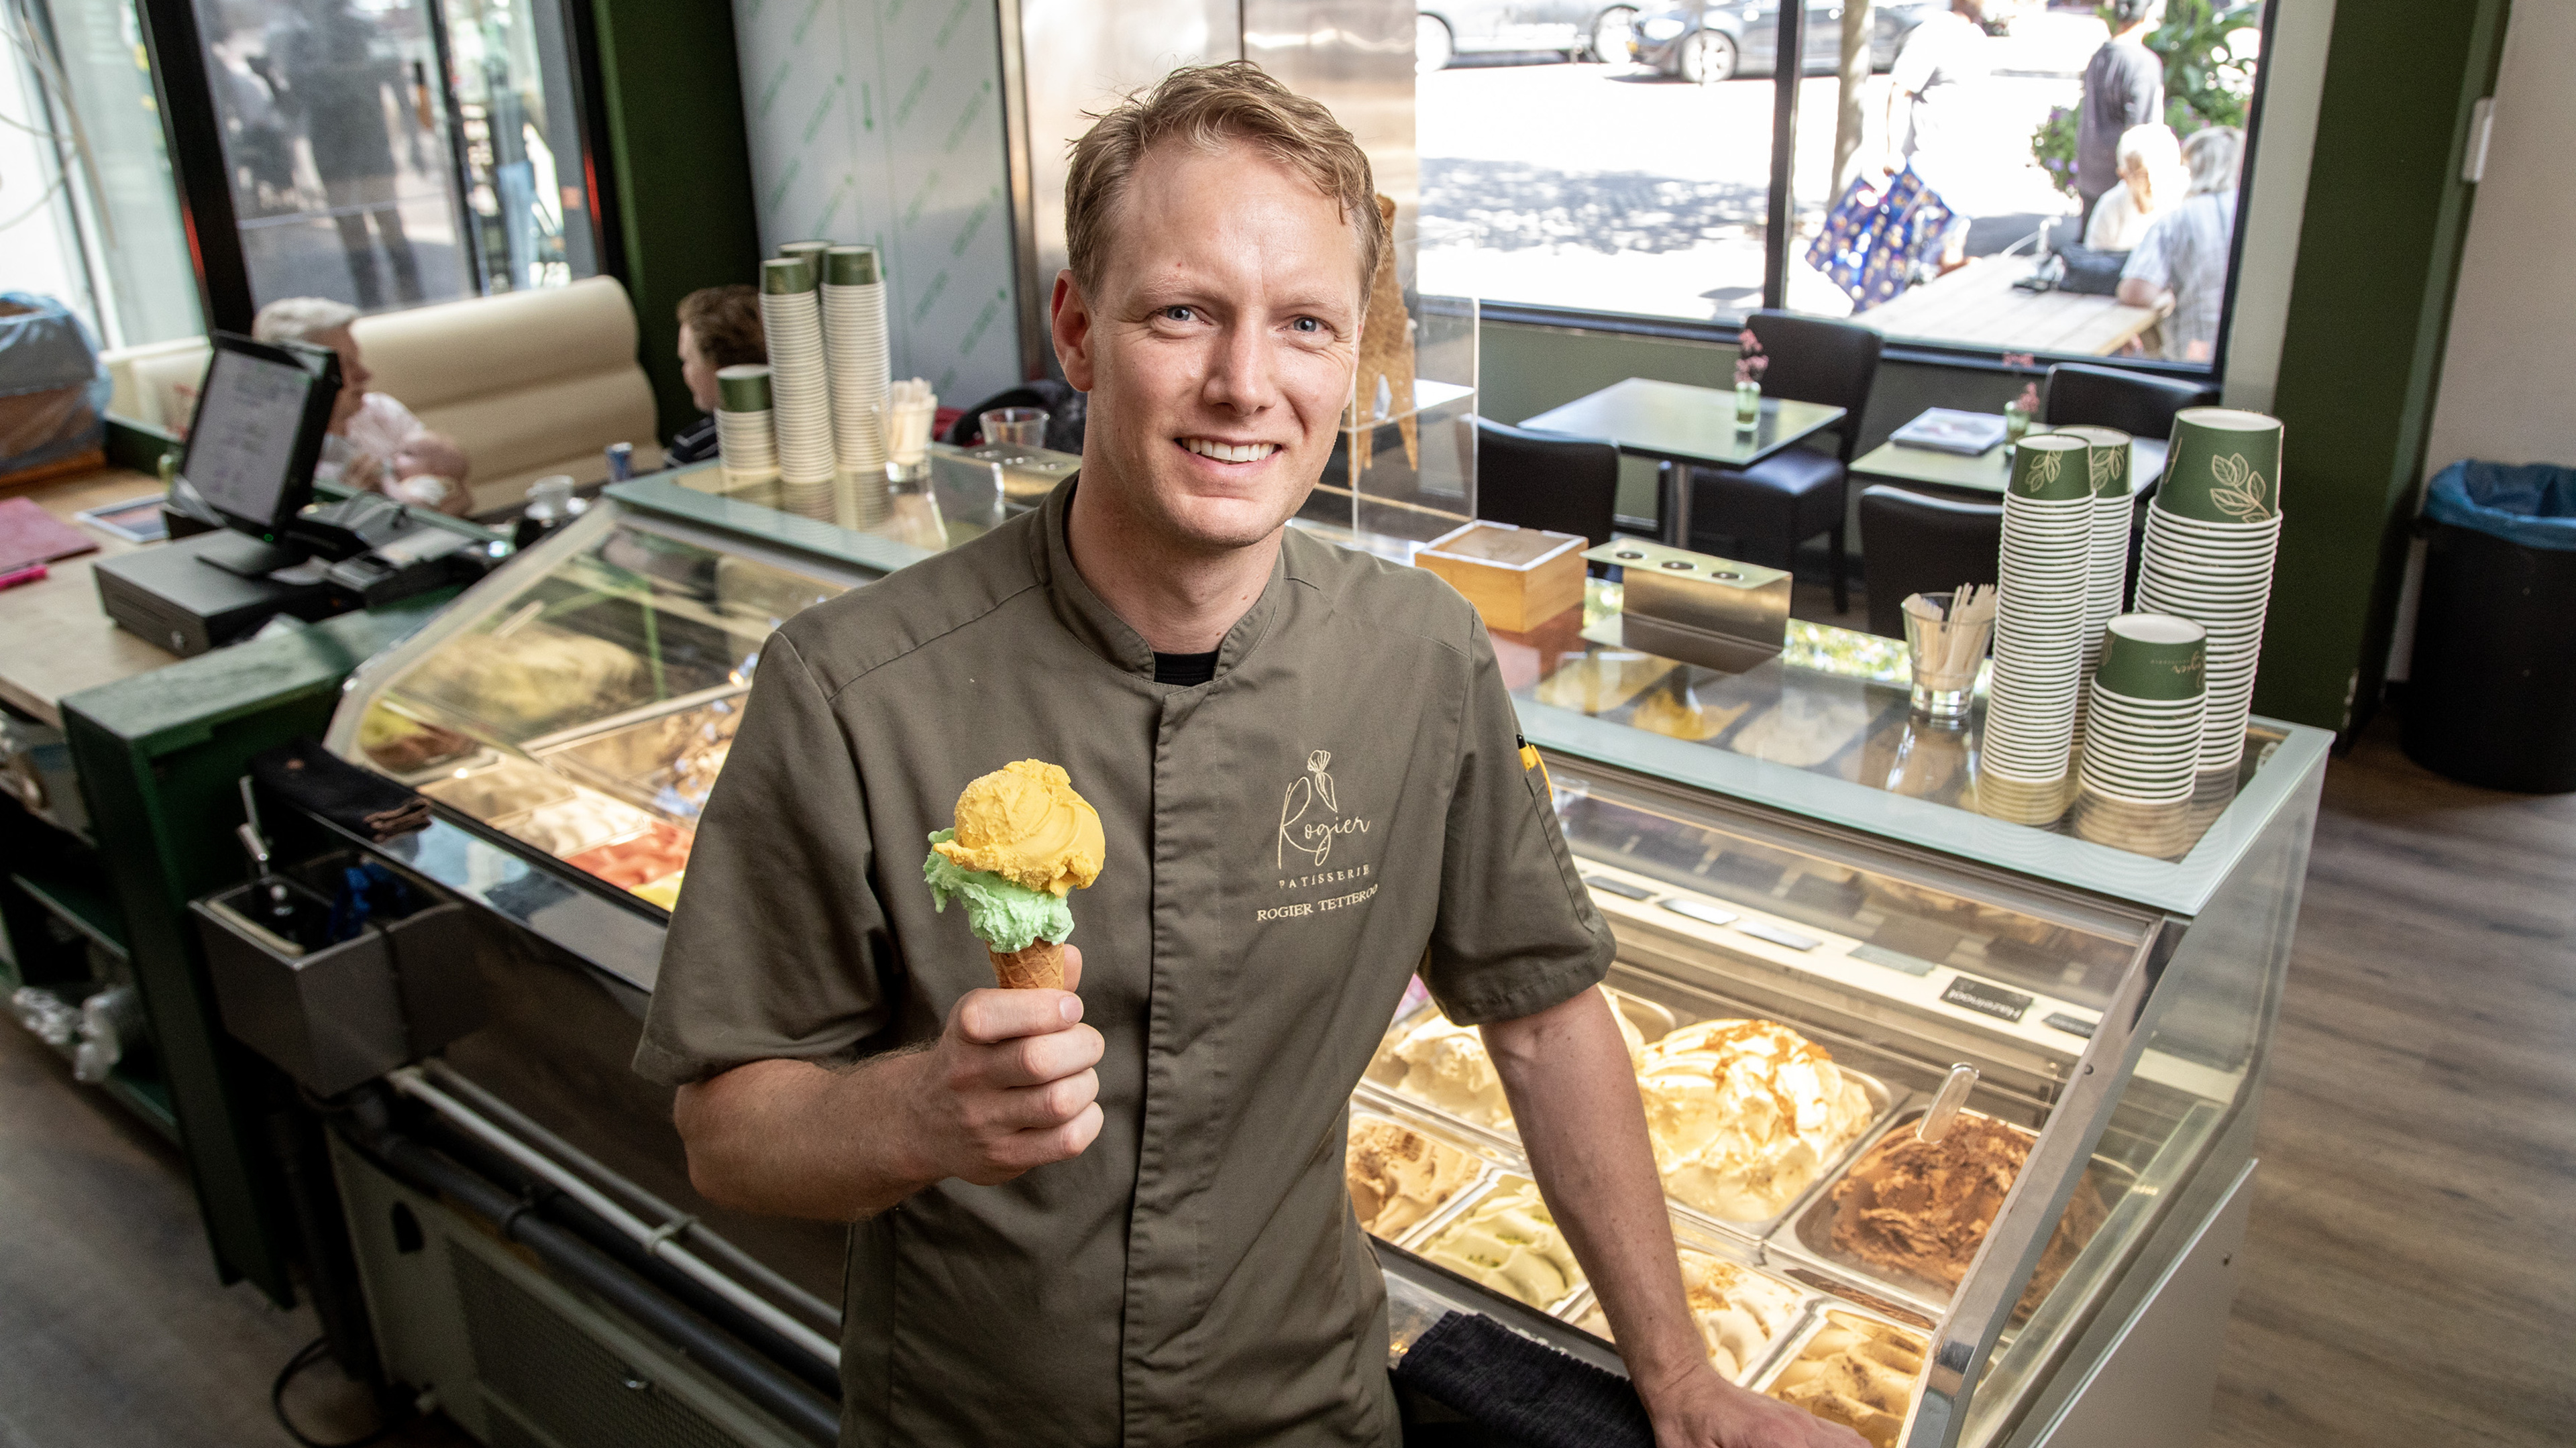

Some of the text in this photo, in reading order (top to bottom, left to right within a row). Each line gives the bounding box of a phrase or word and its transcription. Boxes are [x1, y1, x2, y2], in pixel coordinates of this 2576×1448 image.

[1278, 776, 1371, 869] Rogier
[1279, 864, 1371, 889] PATISSERIE
[1256, 903, 1313, 922] ROGIER
[1947, 989, 2023, 1019] Hazelnoot
